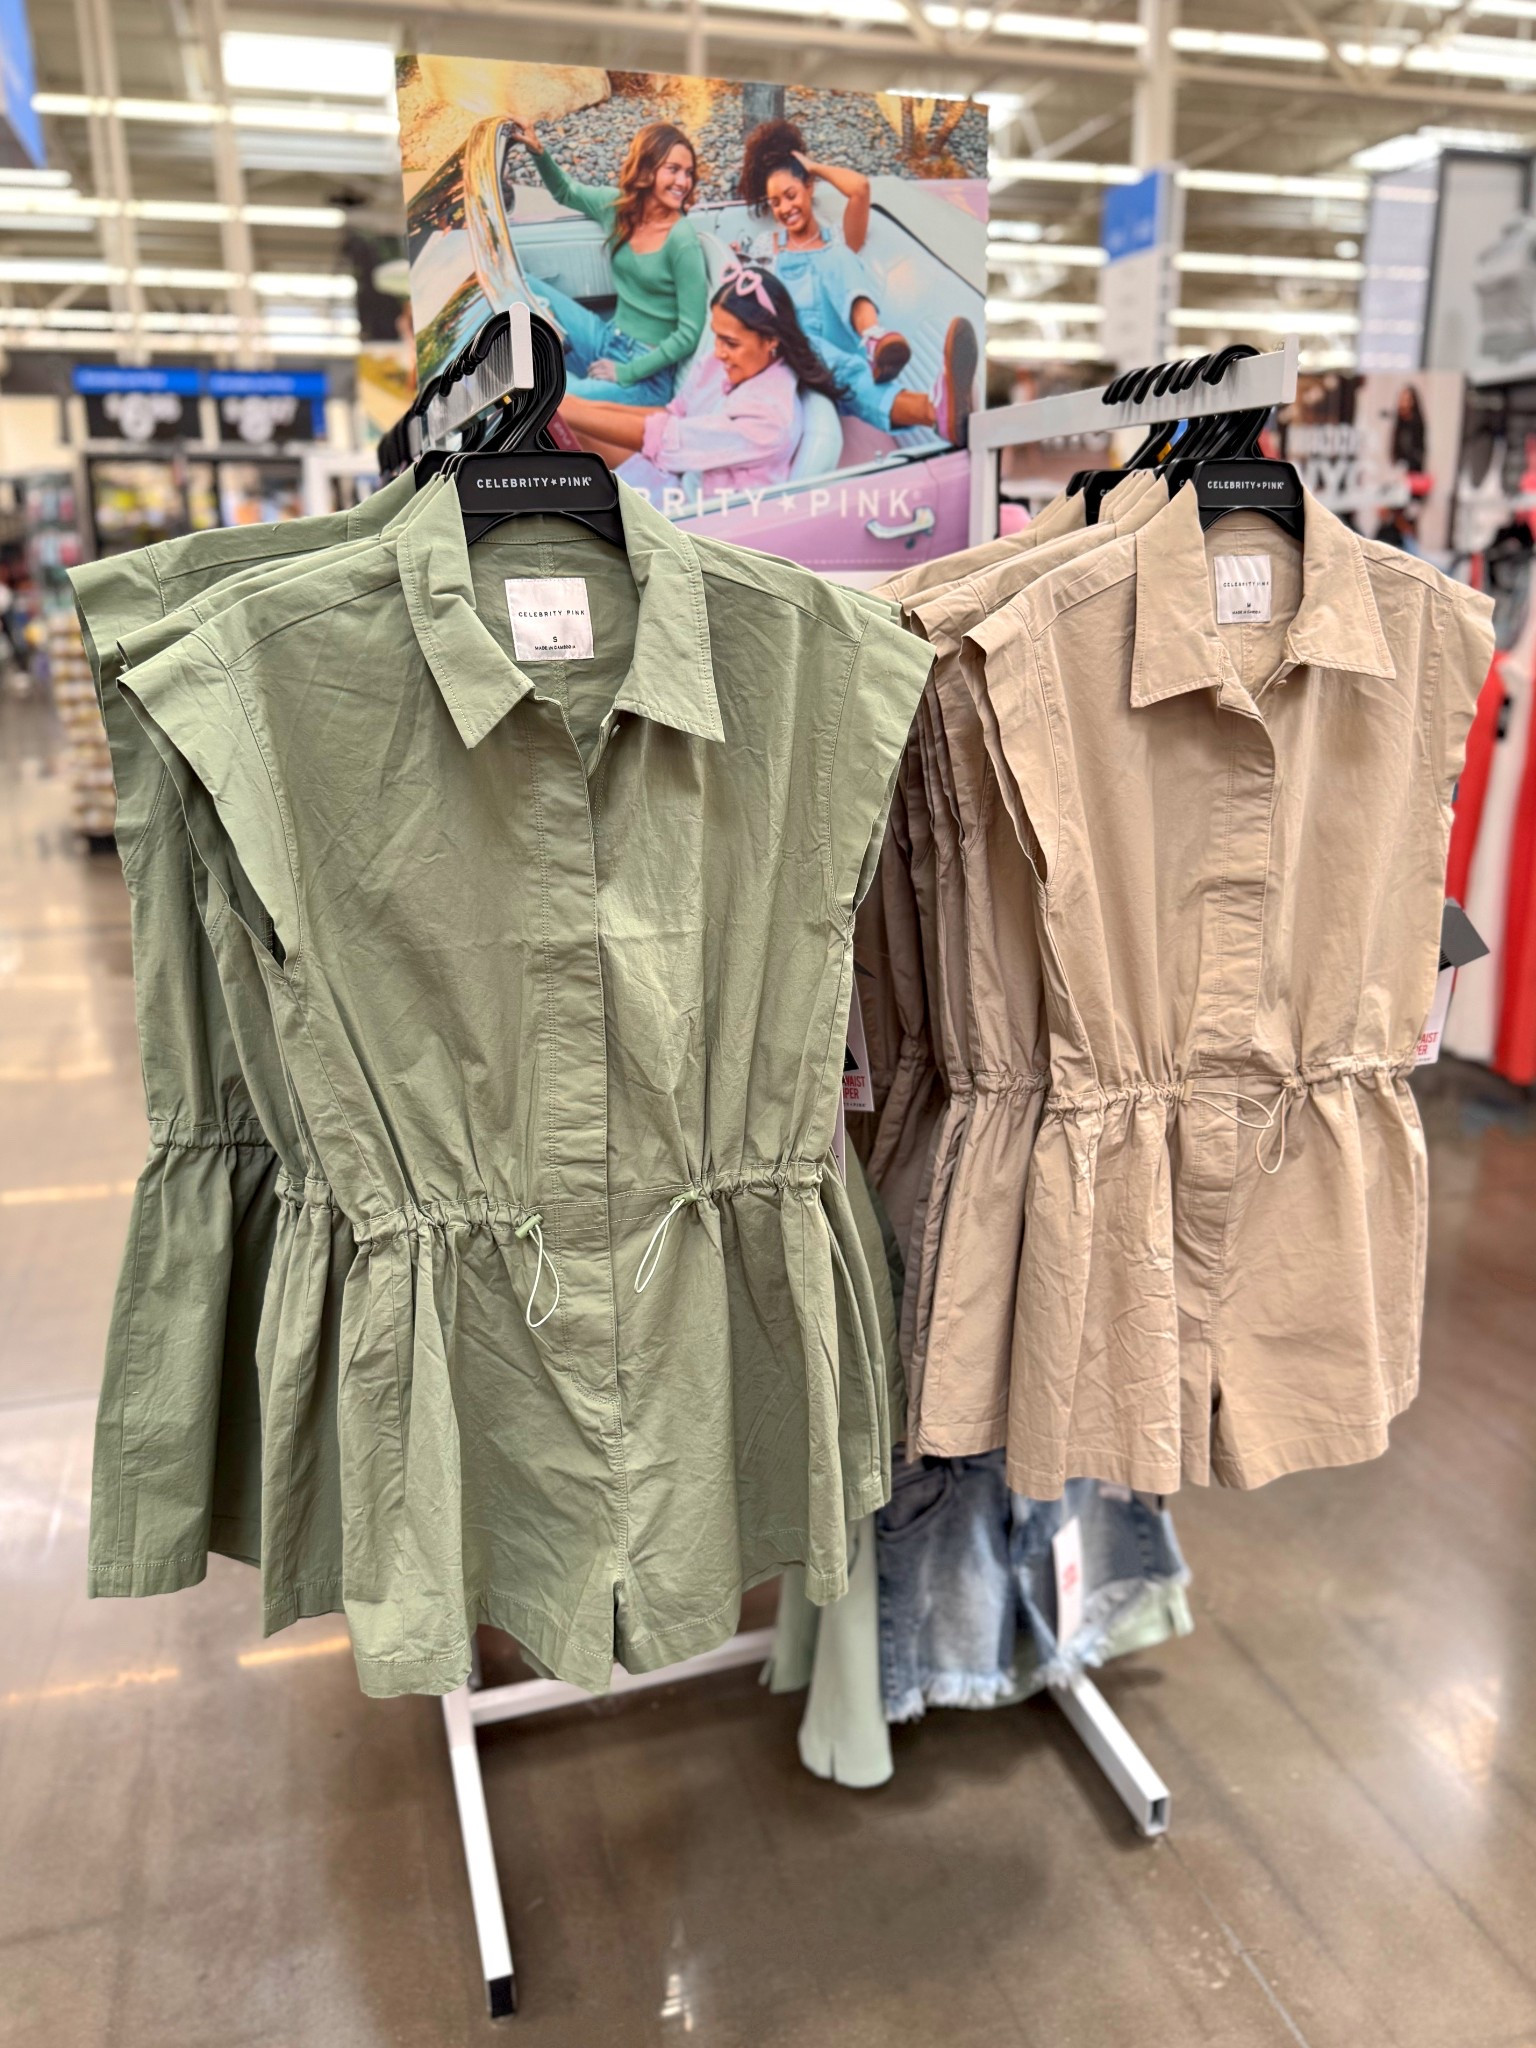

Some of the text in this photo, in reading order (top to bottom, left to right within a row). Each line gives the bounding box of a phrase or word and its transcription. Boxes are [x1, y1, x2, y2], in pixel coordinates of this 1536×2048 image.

[476, 477, 549, 489] CELEBRITY
[1207, 481, 1256, 490] CELEBRITY
[811, 488, 911, 518] PINK
[518, 610, 562, 618] CELEBRITY
